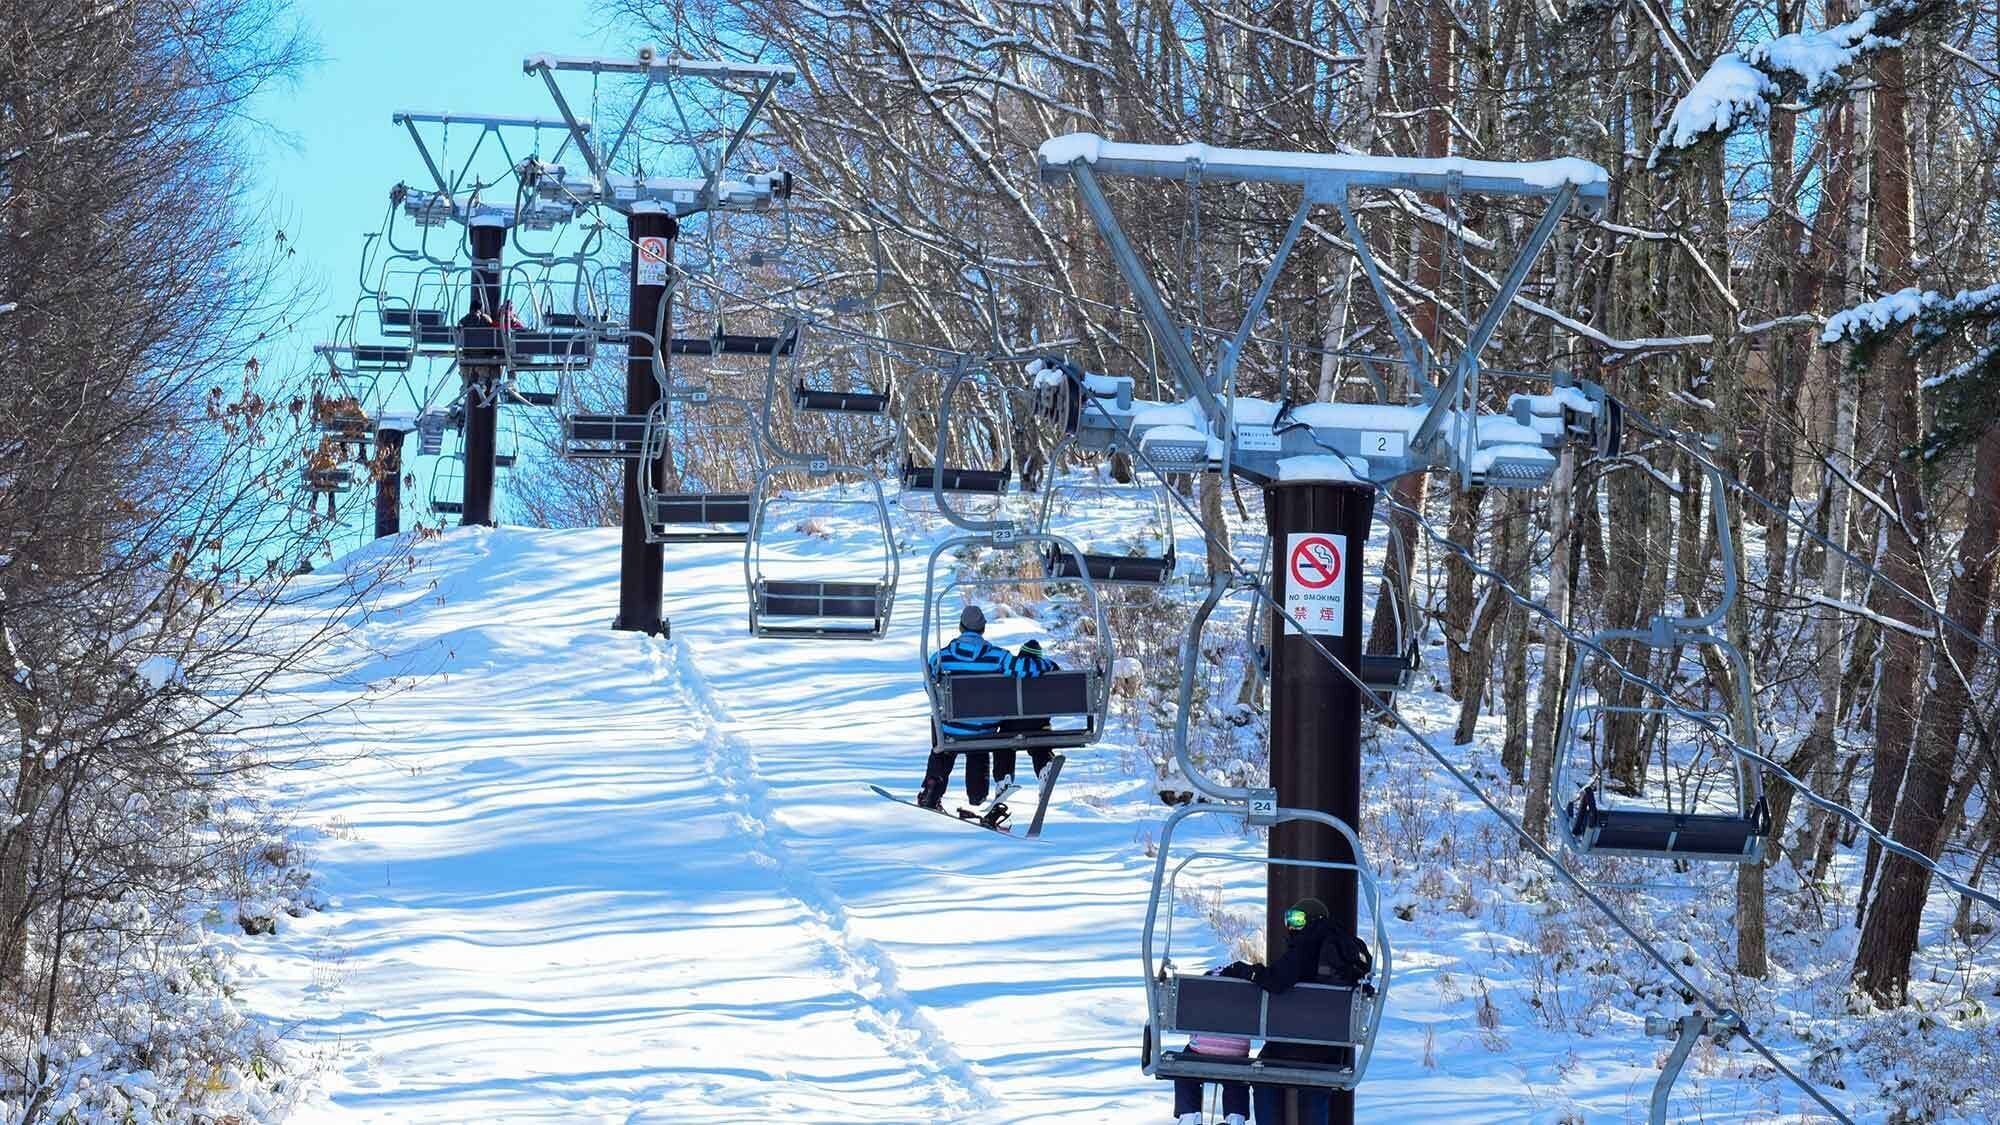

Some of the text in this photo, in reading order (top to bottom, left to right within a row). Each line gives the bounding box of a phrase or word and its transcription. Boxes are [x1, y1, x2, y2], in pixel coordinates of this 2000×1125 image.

[1378, 437, 1387, 451] 2
[996, 531, 1011, 539] 23
[1289, 593, 1341, 602] NO SMOKING
[1294, 606, 1335, 621] 禁煙
[1254, 801, 1271, 811] 24
